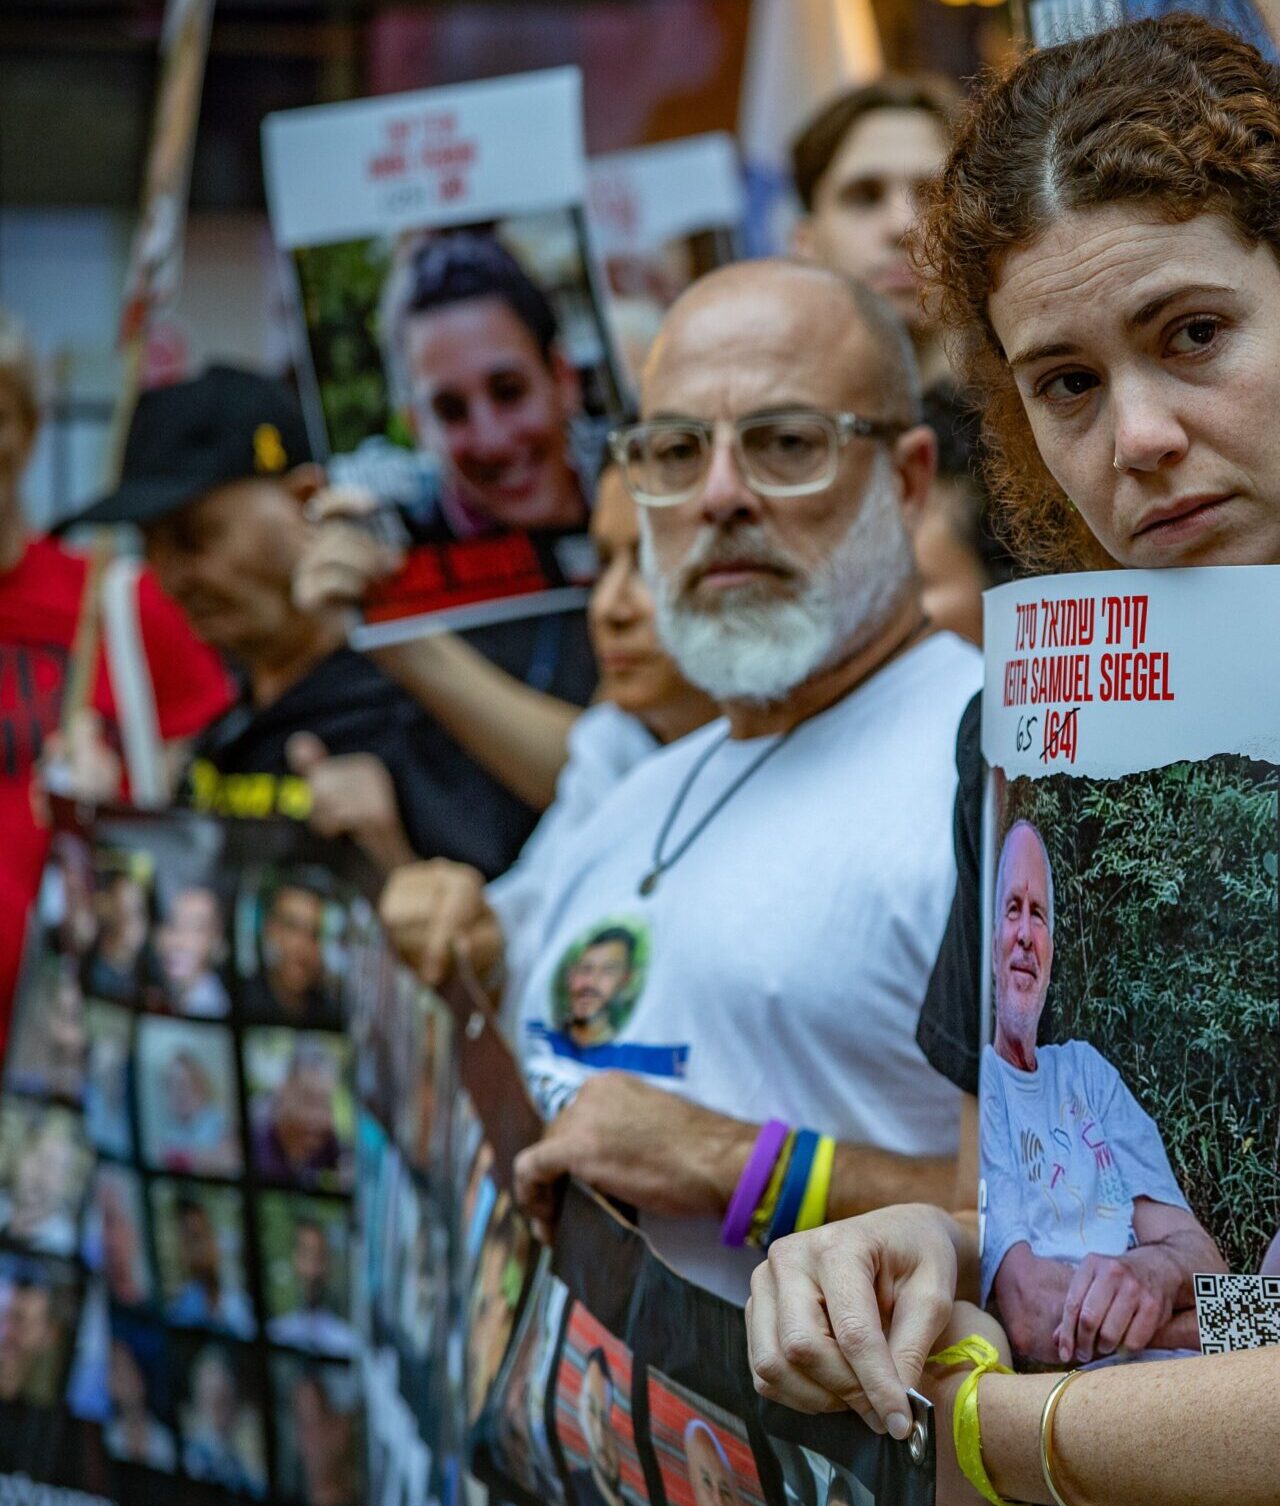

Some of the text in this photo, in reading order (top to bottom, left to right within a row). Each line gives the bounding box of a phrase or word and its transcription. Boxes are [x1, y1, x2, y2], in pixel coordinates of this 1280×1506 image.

[1015, 595, 1148, 651] קית' שמואל סיגל
[1003, 652, 1175, 707] KEITH SAMUEL SIEGEL
[1016, 715, 1037, 752] 65
